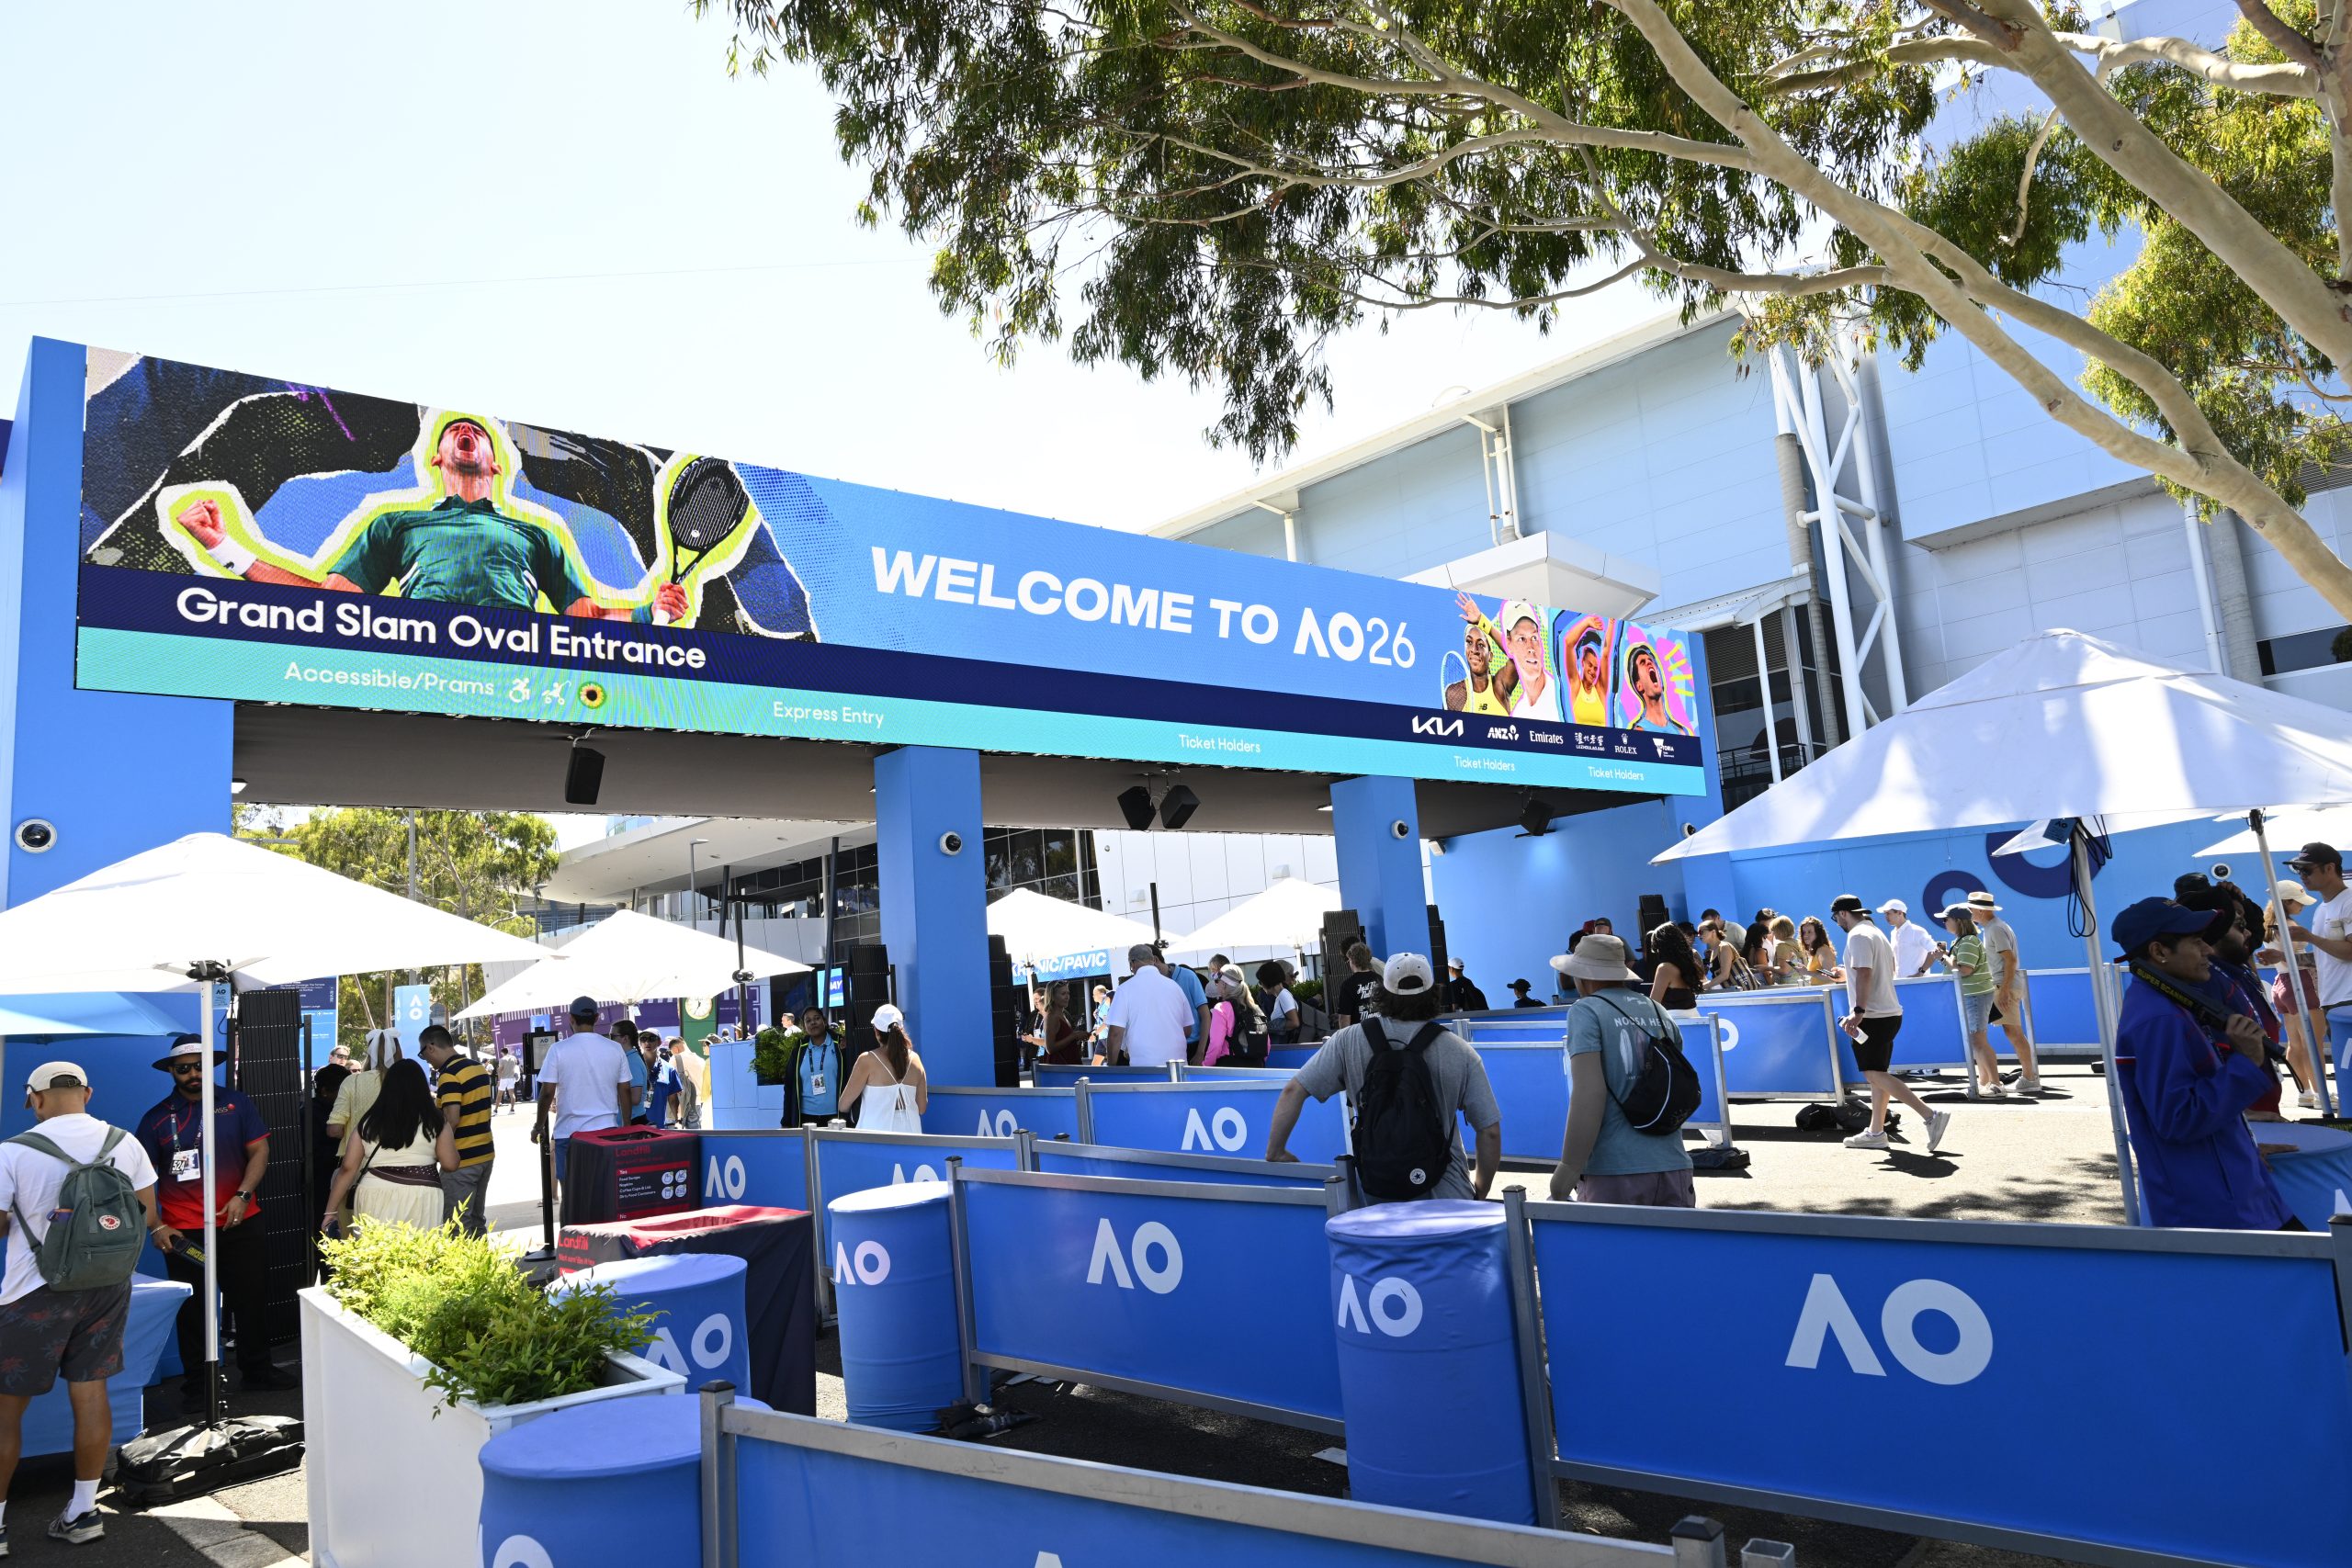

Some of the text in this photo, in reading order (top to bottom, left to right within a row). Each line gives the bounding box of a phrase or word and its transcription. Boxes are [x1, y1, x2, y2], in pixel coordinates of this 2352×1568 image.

[872, 547, 1193, 634] WELCOME
[1210, 598, 1279, 645] TO
[176, 587, 707, 669] Grand Slam Oval Entrance
[284, 662, 494, 696] Accessible/Prams
[774, 701, 884, 729] Express Entry
[1179, 734, 1261, 753] Ticket Holders
[1487, 727, 1509, 740] ANZ
[1530, 730, 1564, 745] Emirates
[1453, 755, 1515, 772] Ticket Holders
[1614, 745, 1638, 755] ROLEX
[1588, 766, 1645, 781] Ticket Holders
[1012, 953, 1106, 976] KRNIC/PAVIC
[2136, 968, 2195, 1008] SUPER SCANNER
[1181, 1107, 1248, 1152] AO
[172, 1160, 186, 1171] 524
[705, 1155, 746, 1200] AO
[559, 1235, 589, 1250] Landfill
[1086, 1218, 1183, 1294] AO
[835, 1240, 891, 1286] AO
[1338, 1273, 1423, 1337] AO
[1784, 1273, 1994, 1385] AO
